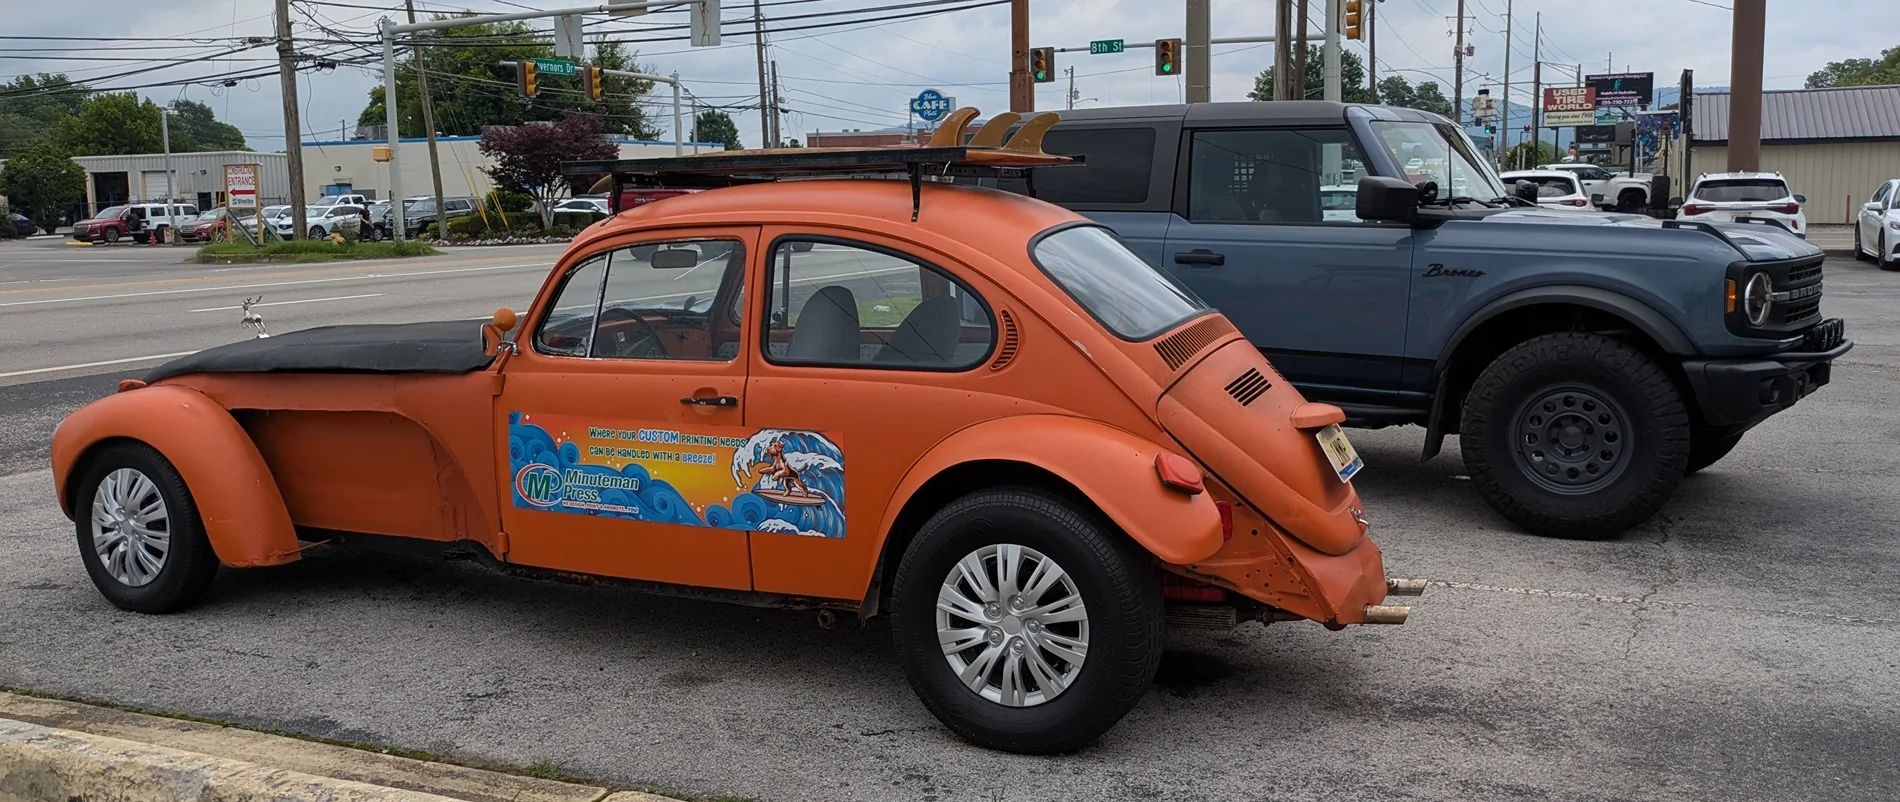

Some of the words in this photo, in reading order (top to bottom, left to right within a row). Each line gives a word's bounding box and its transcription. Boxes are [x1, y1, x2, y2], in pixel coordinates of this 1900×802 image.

[1092, 42, 1108, 53] 8th
[1113, 41, 1122, 51] St
[537, 62, 564, 73] overnors
[566, 63, 573, 73] Dr
[1552, 88, 1587, 96] USED
[1553, 95, 1586, 104] TIRE
[913, 100, 947, 110] CAFE
[1547, 103, 1592, 111] WORLD
[229, 177, 255, 186] ENTRANCE
[1422, 263, 1486, 277] Bronco
[618, 430, 637, 441] YOUR
[638, 428, 679, 444] CUSTOM
[681, 434, 718, 446] PRINTING
[652, 451, 673, 461] WITH
[565, 468, 639, 490] Minuteman
